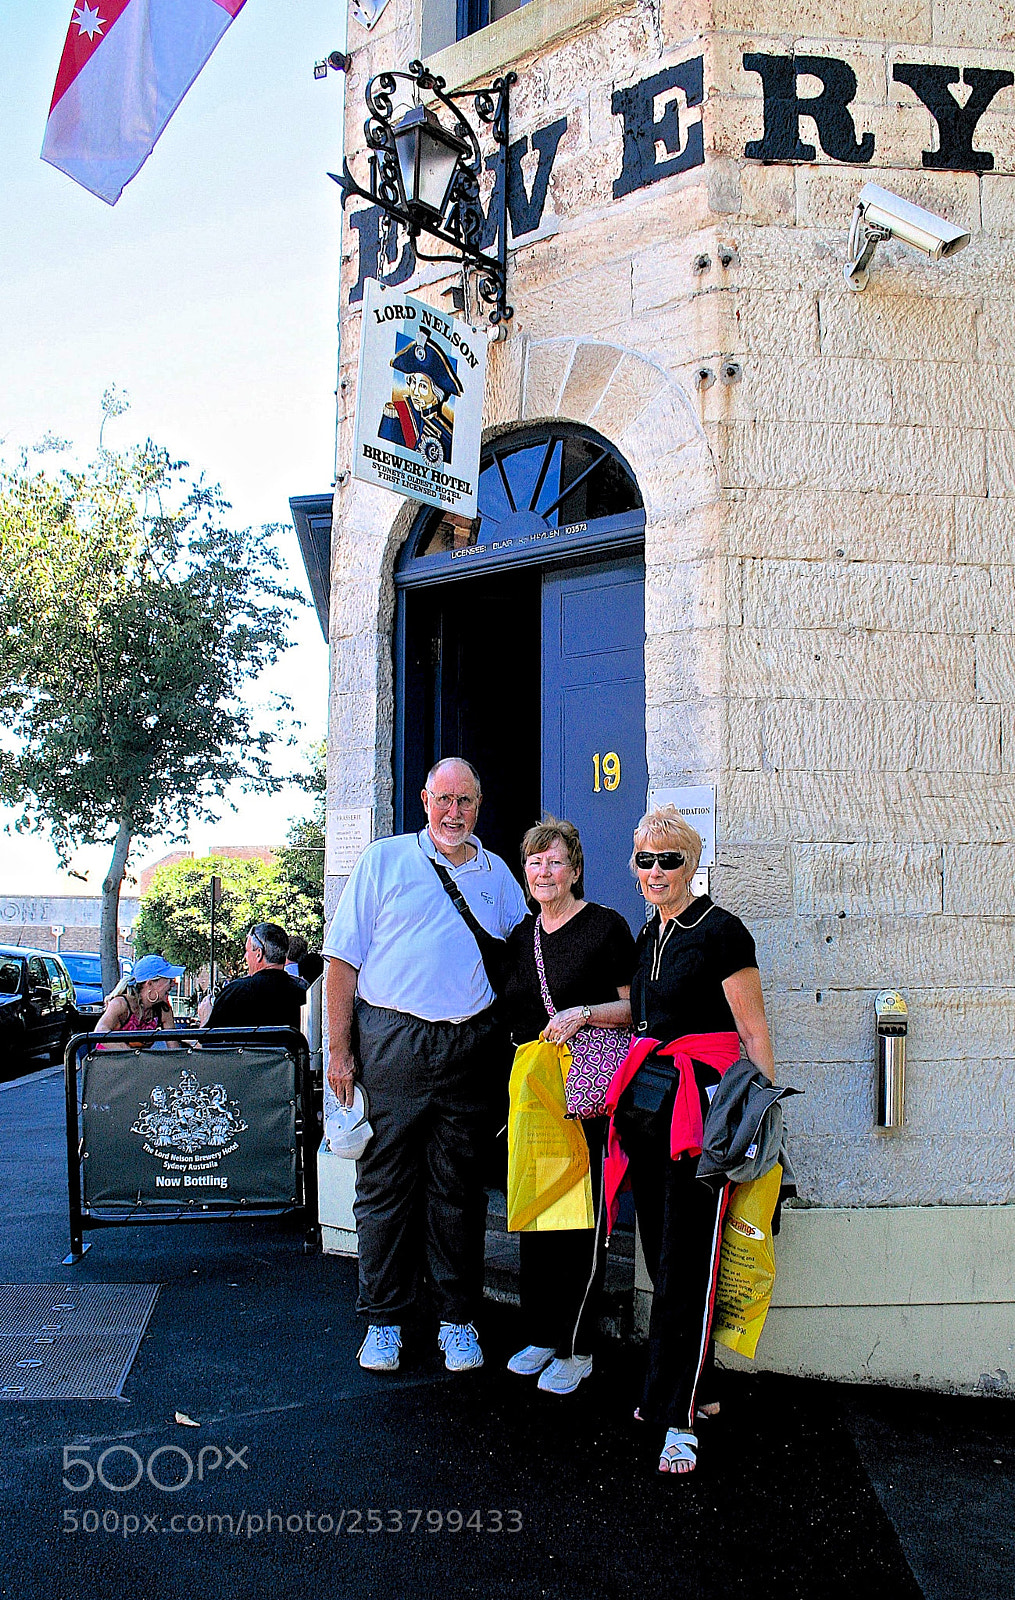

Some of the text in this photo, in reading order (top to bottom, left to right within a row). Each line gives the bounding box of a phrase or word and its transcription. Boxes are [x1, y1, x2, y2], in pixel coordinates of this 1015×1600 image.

[373, 304, 479, 369] LORD NELSON
[362, 444, 473, 496] BREWERY HOTEL
[378, 471, 400, 484] FIRST
[402, 480, 437, 497] LICENSED
[407, 474, 433, 489] OLDEST
[435, 484, 462, 500] HOTEL
[592, 751, 621, 793] 19
[679, 806, 710, 815] ODATION
[142, 1141, 240, 1162] The Lord Nelson Brewery Hotel
[163, 1160, 218, 1172] Sydney Australia
[155, 1175, 228, 1189] Now Bottling
